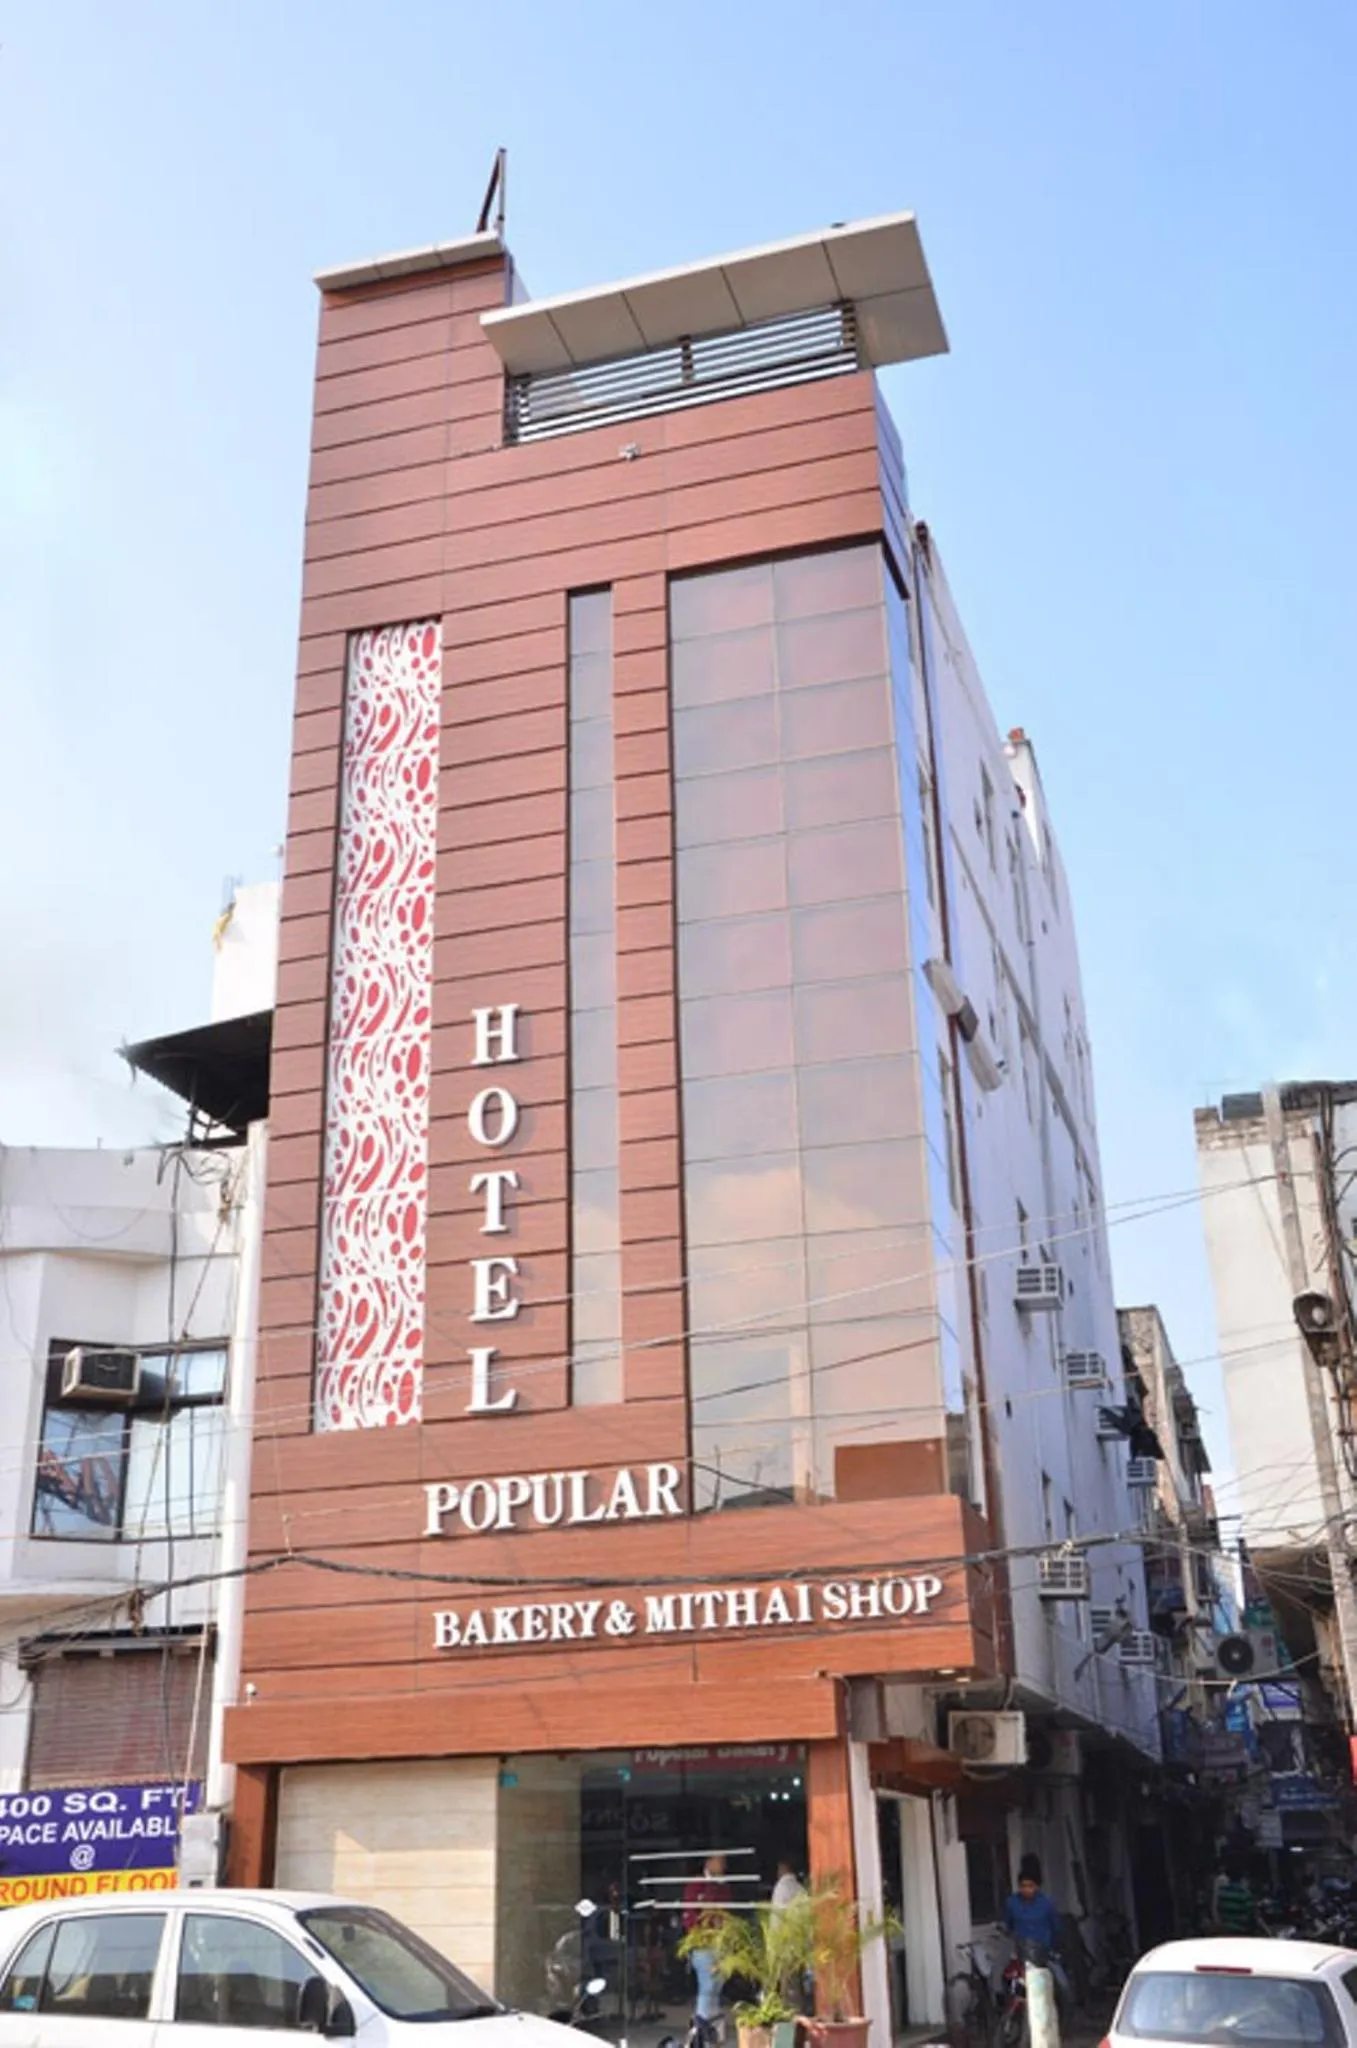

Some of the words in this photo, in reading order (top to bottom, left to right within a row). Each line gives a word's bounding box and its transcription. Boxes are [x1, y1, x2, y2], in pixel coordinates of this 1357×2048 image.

[466, 1003, 520, 1414] HOTEL
[422, 1463, 683, 1536] POPULAR
[433, 1601, 602, 1648] BAKERY
[604, 1600, 636, 1635] &
[645, 1585, 813, 1632] MITHAI
[822, 1574, 942, 1620] SHOP
[63, 1791, 128, 1814] SQ.
[141, 1786, 193, 1810] FT.
[69, 1844, 96, 1871] @
